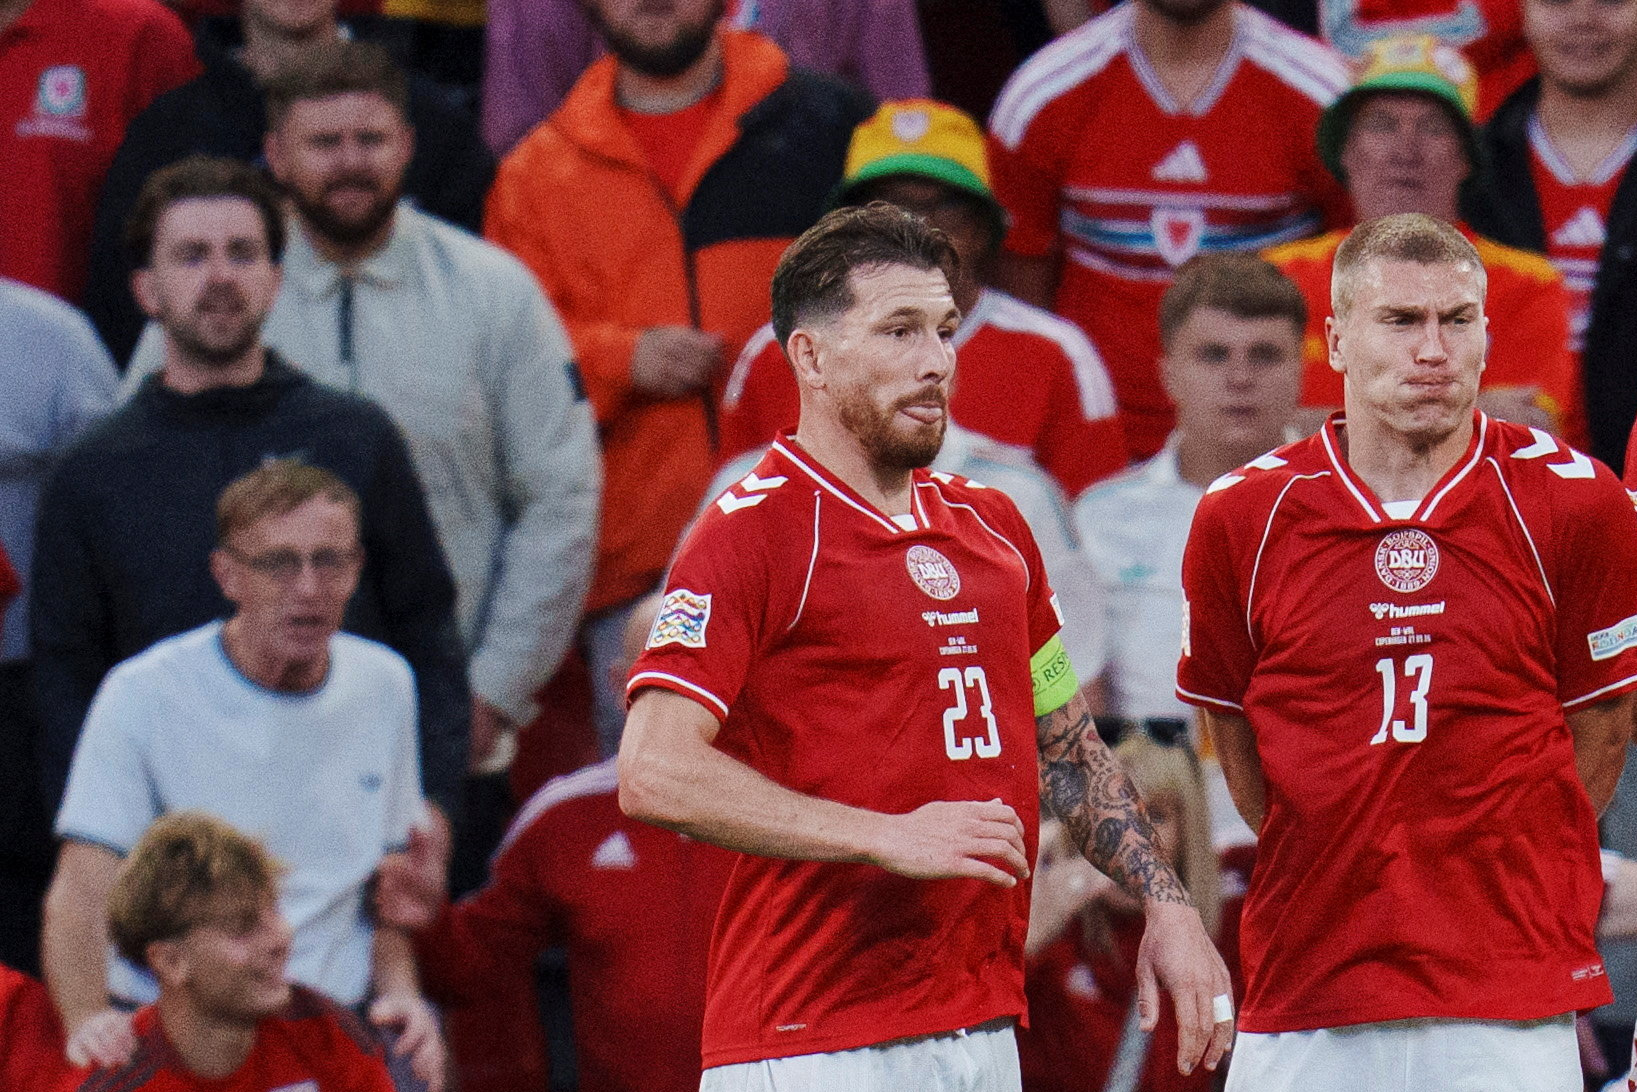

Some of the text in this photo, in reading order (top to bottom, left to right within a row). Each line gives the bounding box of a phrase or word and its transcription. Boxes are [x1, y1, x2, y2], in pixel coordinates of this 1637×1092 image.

[1388, 549, 1426, 568] DBU
[936, 607, 979, 626] hummel
[1389, 600, 1445, 619] hummel
[1370, 653, 1434, 745] 13
[938, 666, 1002, 760] 23
